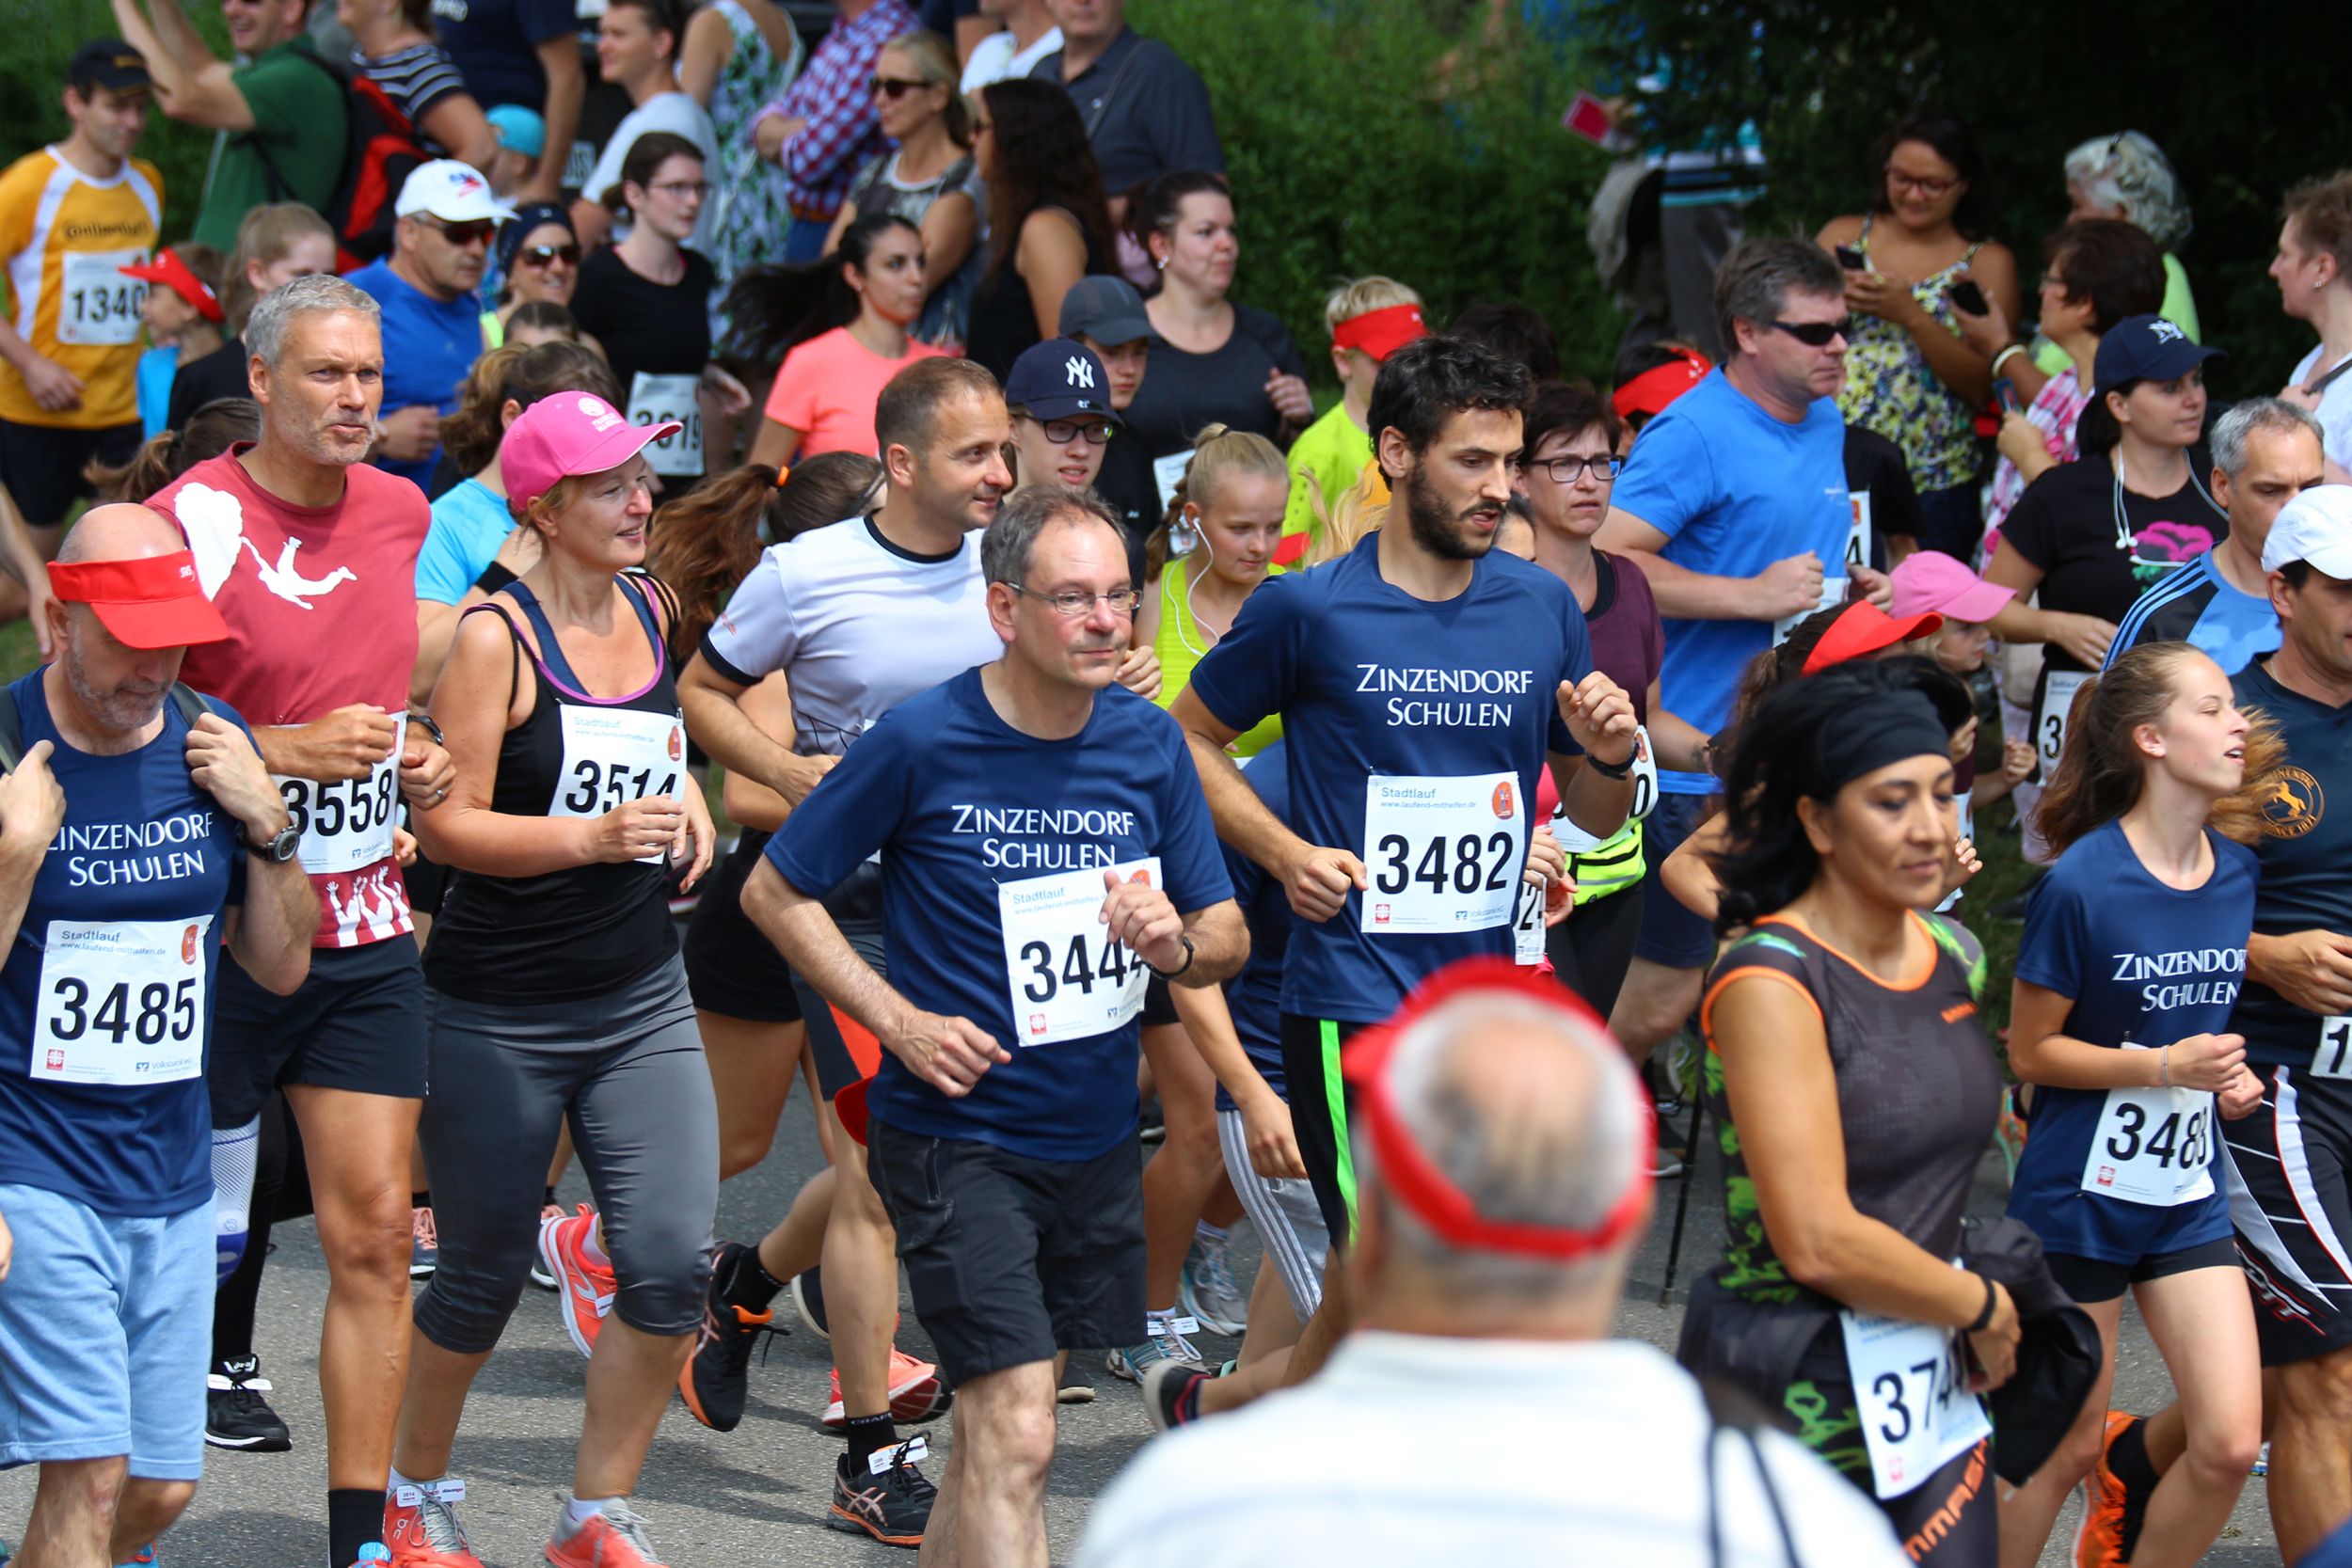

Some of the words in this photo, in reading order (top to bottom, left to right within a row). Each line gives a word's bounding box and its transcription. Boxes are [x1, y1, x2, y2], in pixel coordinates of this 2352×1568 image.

[72, 284, 146, 323] 1340
[1356, 664, 1534, 694] ZINZENDORF
[573, 717, 621, 729] Stadtlauf
[1387, 697, 1512, 727] SCHULEN
[279, 768, 393, 836] 3558
[1381, 786, 1437, 800] Stadtlauf
[951, 804, 1135, 836] ZINZENDORF
[69, 849, 205, 887] SCHULEN
[982, 838, 1116, 869] SCHULEN
[1376, 832, 1513, 895] 3482
[1013, 886, 1065, 905] Stadtlauf
[1014, 894, 1107, 914] www.laufend-mithelfen.d
[60, 942, 167, 955] www.laufend-mithelfen.de
[61, 930, 120, 942] Stadtlauf
[2111, 948, 2248, 981] ZINZENDOR
[50, 976, 197, 1045] 3485
[2140, 981, 2241, 1012] SCHULEN
